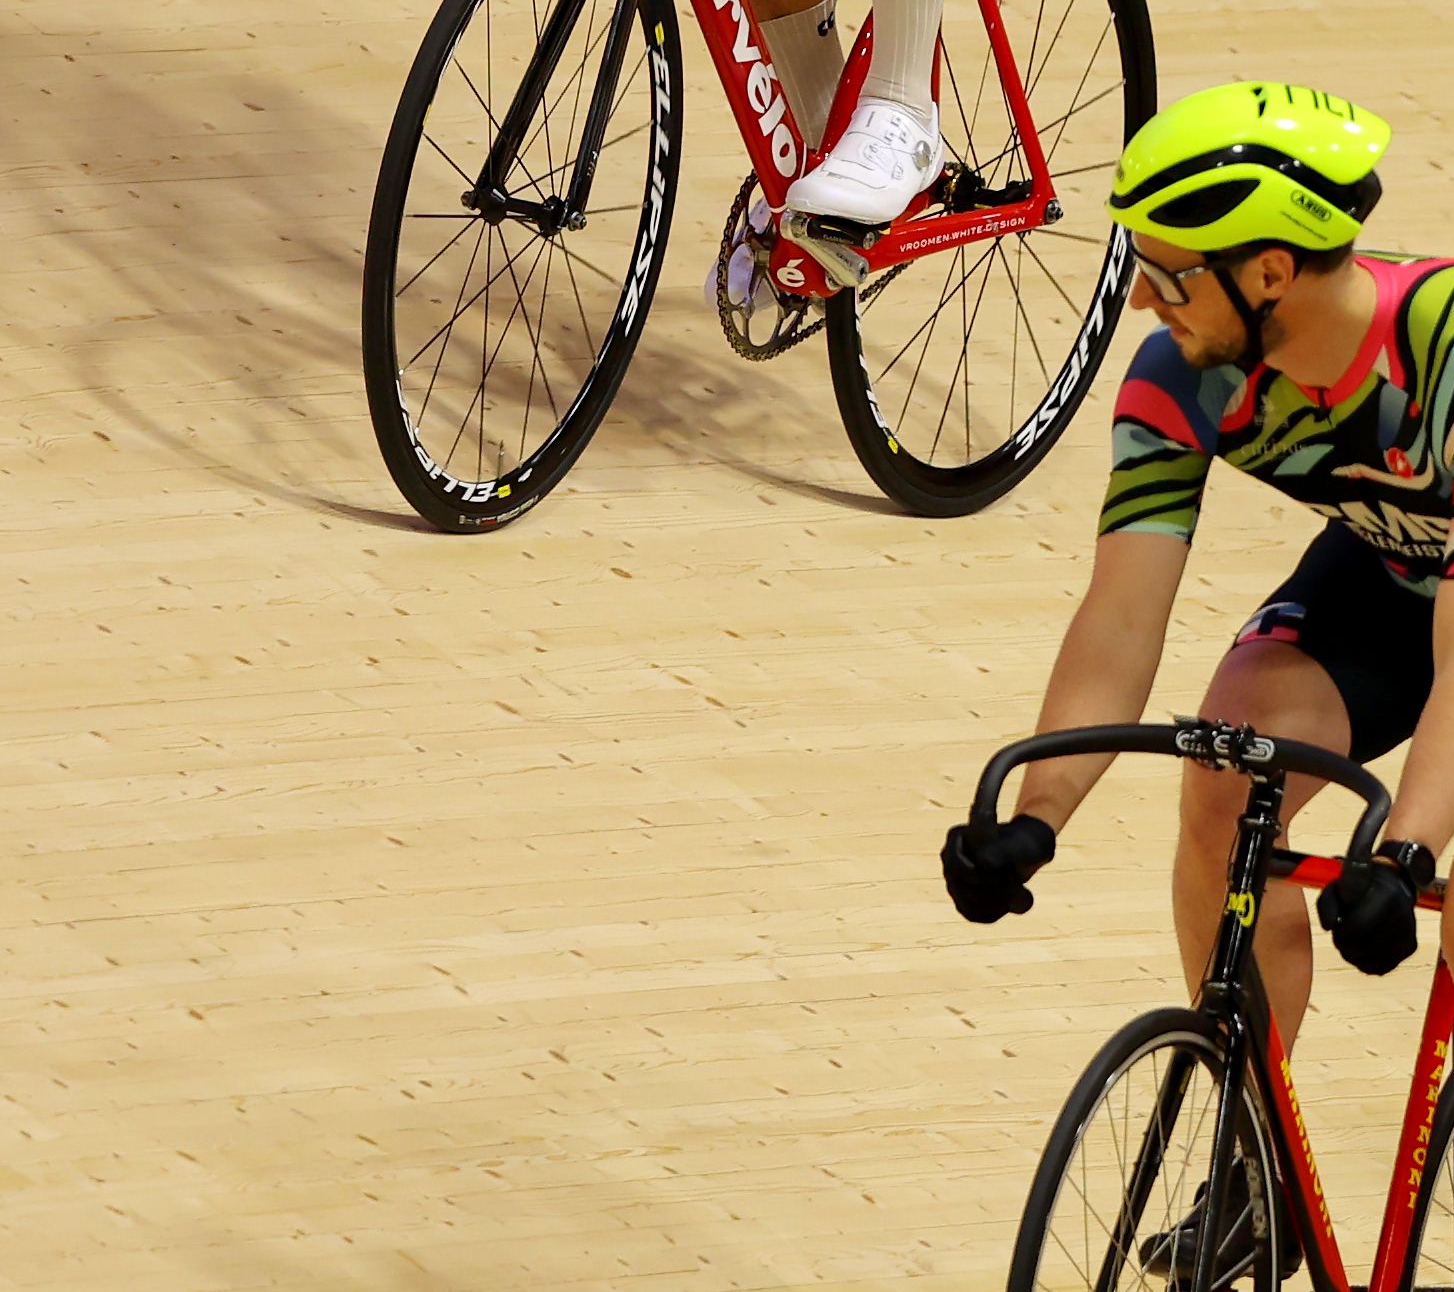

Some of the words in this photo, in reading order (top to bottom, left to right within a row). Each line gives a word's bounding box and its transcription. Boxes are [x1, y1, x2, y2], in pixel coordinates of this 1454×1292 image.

[620, 49, 672, 338] ELLIPSE
[1014, 224, 1129, 461] ELLIPSE
[1407, 1039, 1449, 1209] MARINONI
